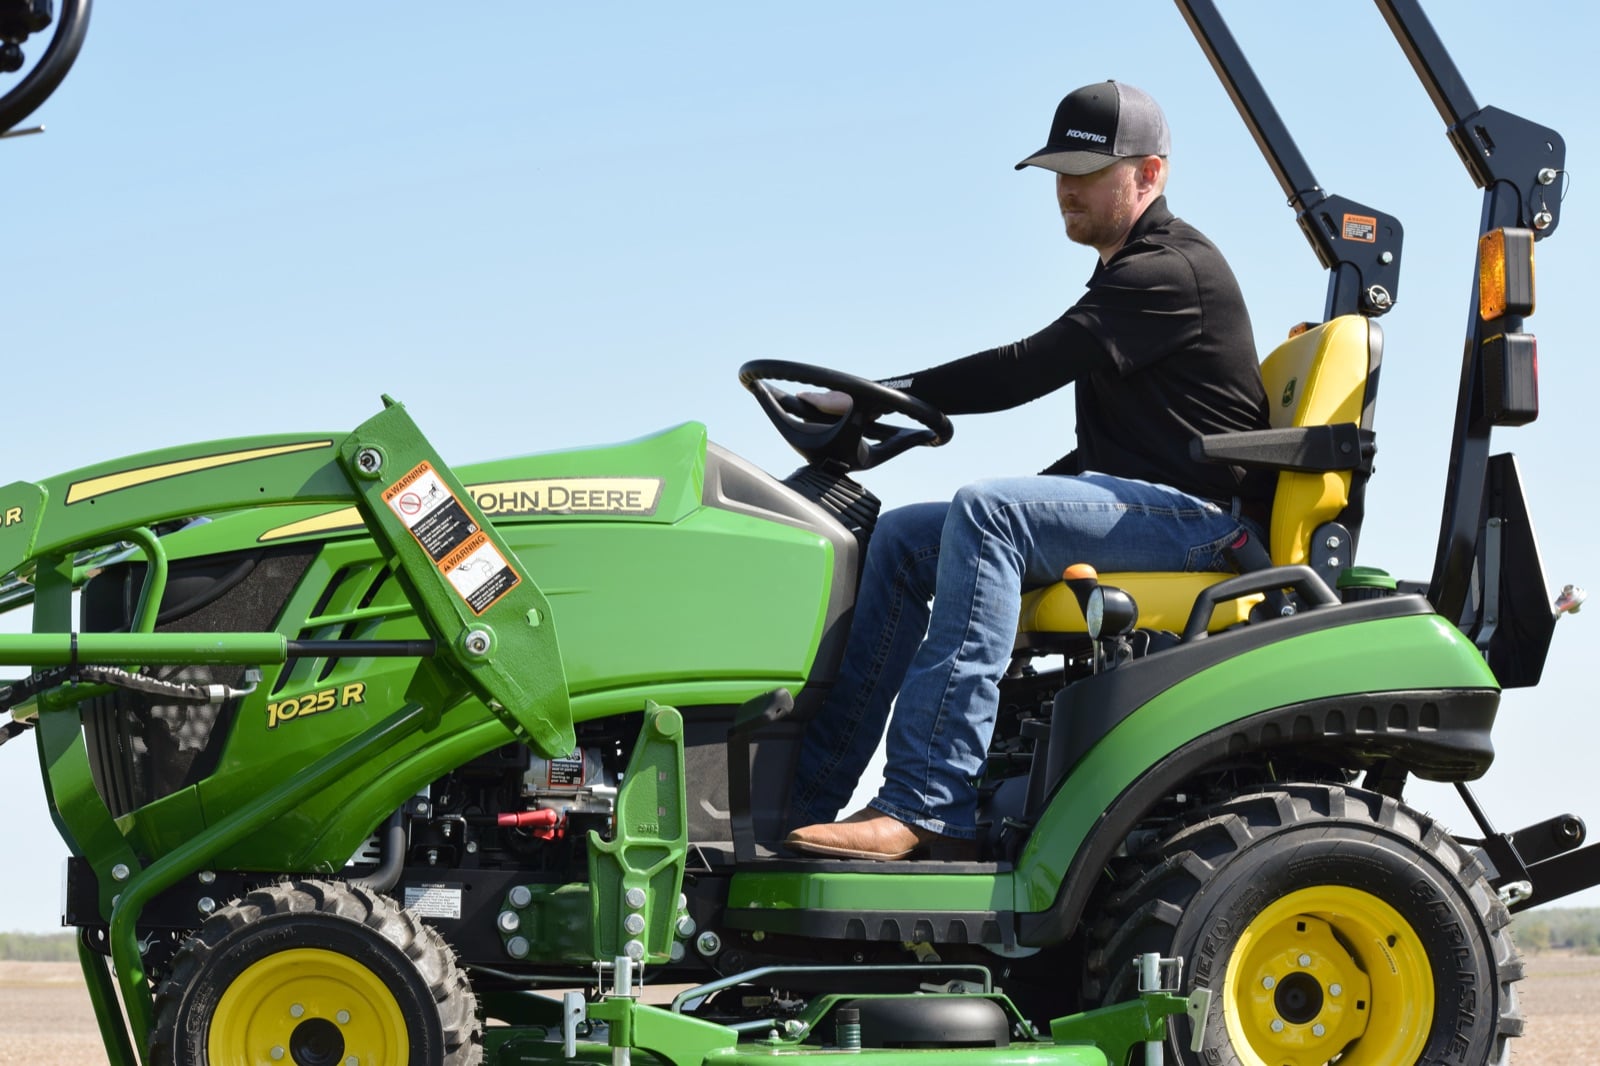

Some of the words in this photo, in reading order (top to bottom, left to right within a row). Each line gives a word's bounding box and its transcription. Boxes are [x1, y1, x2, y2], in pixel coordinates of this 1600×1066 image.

[390, 463, 428, 494] WARNING
[548, 486, 642, 508] DEERE
[447, 535, 485, 566] WARNING
[267, 688, 337, 728] 1025
[341, 682, 365, 706] R
